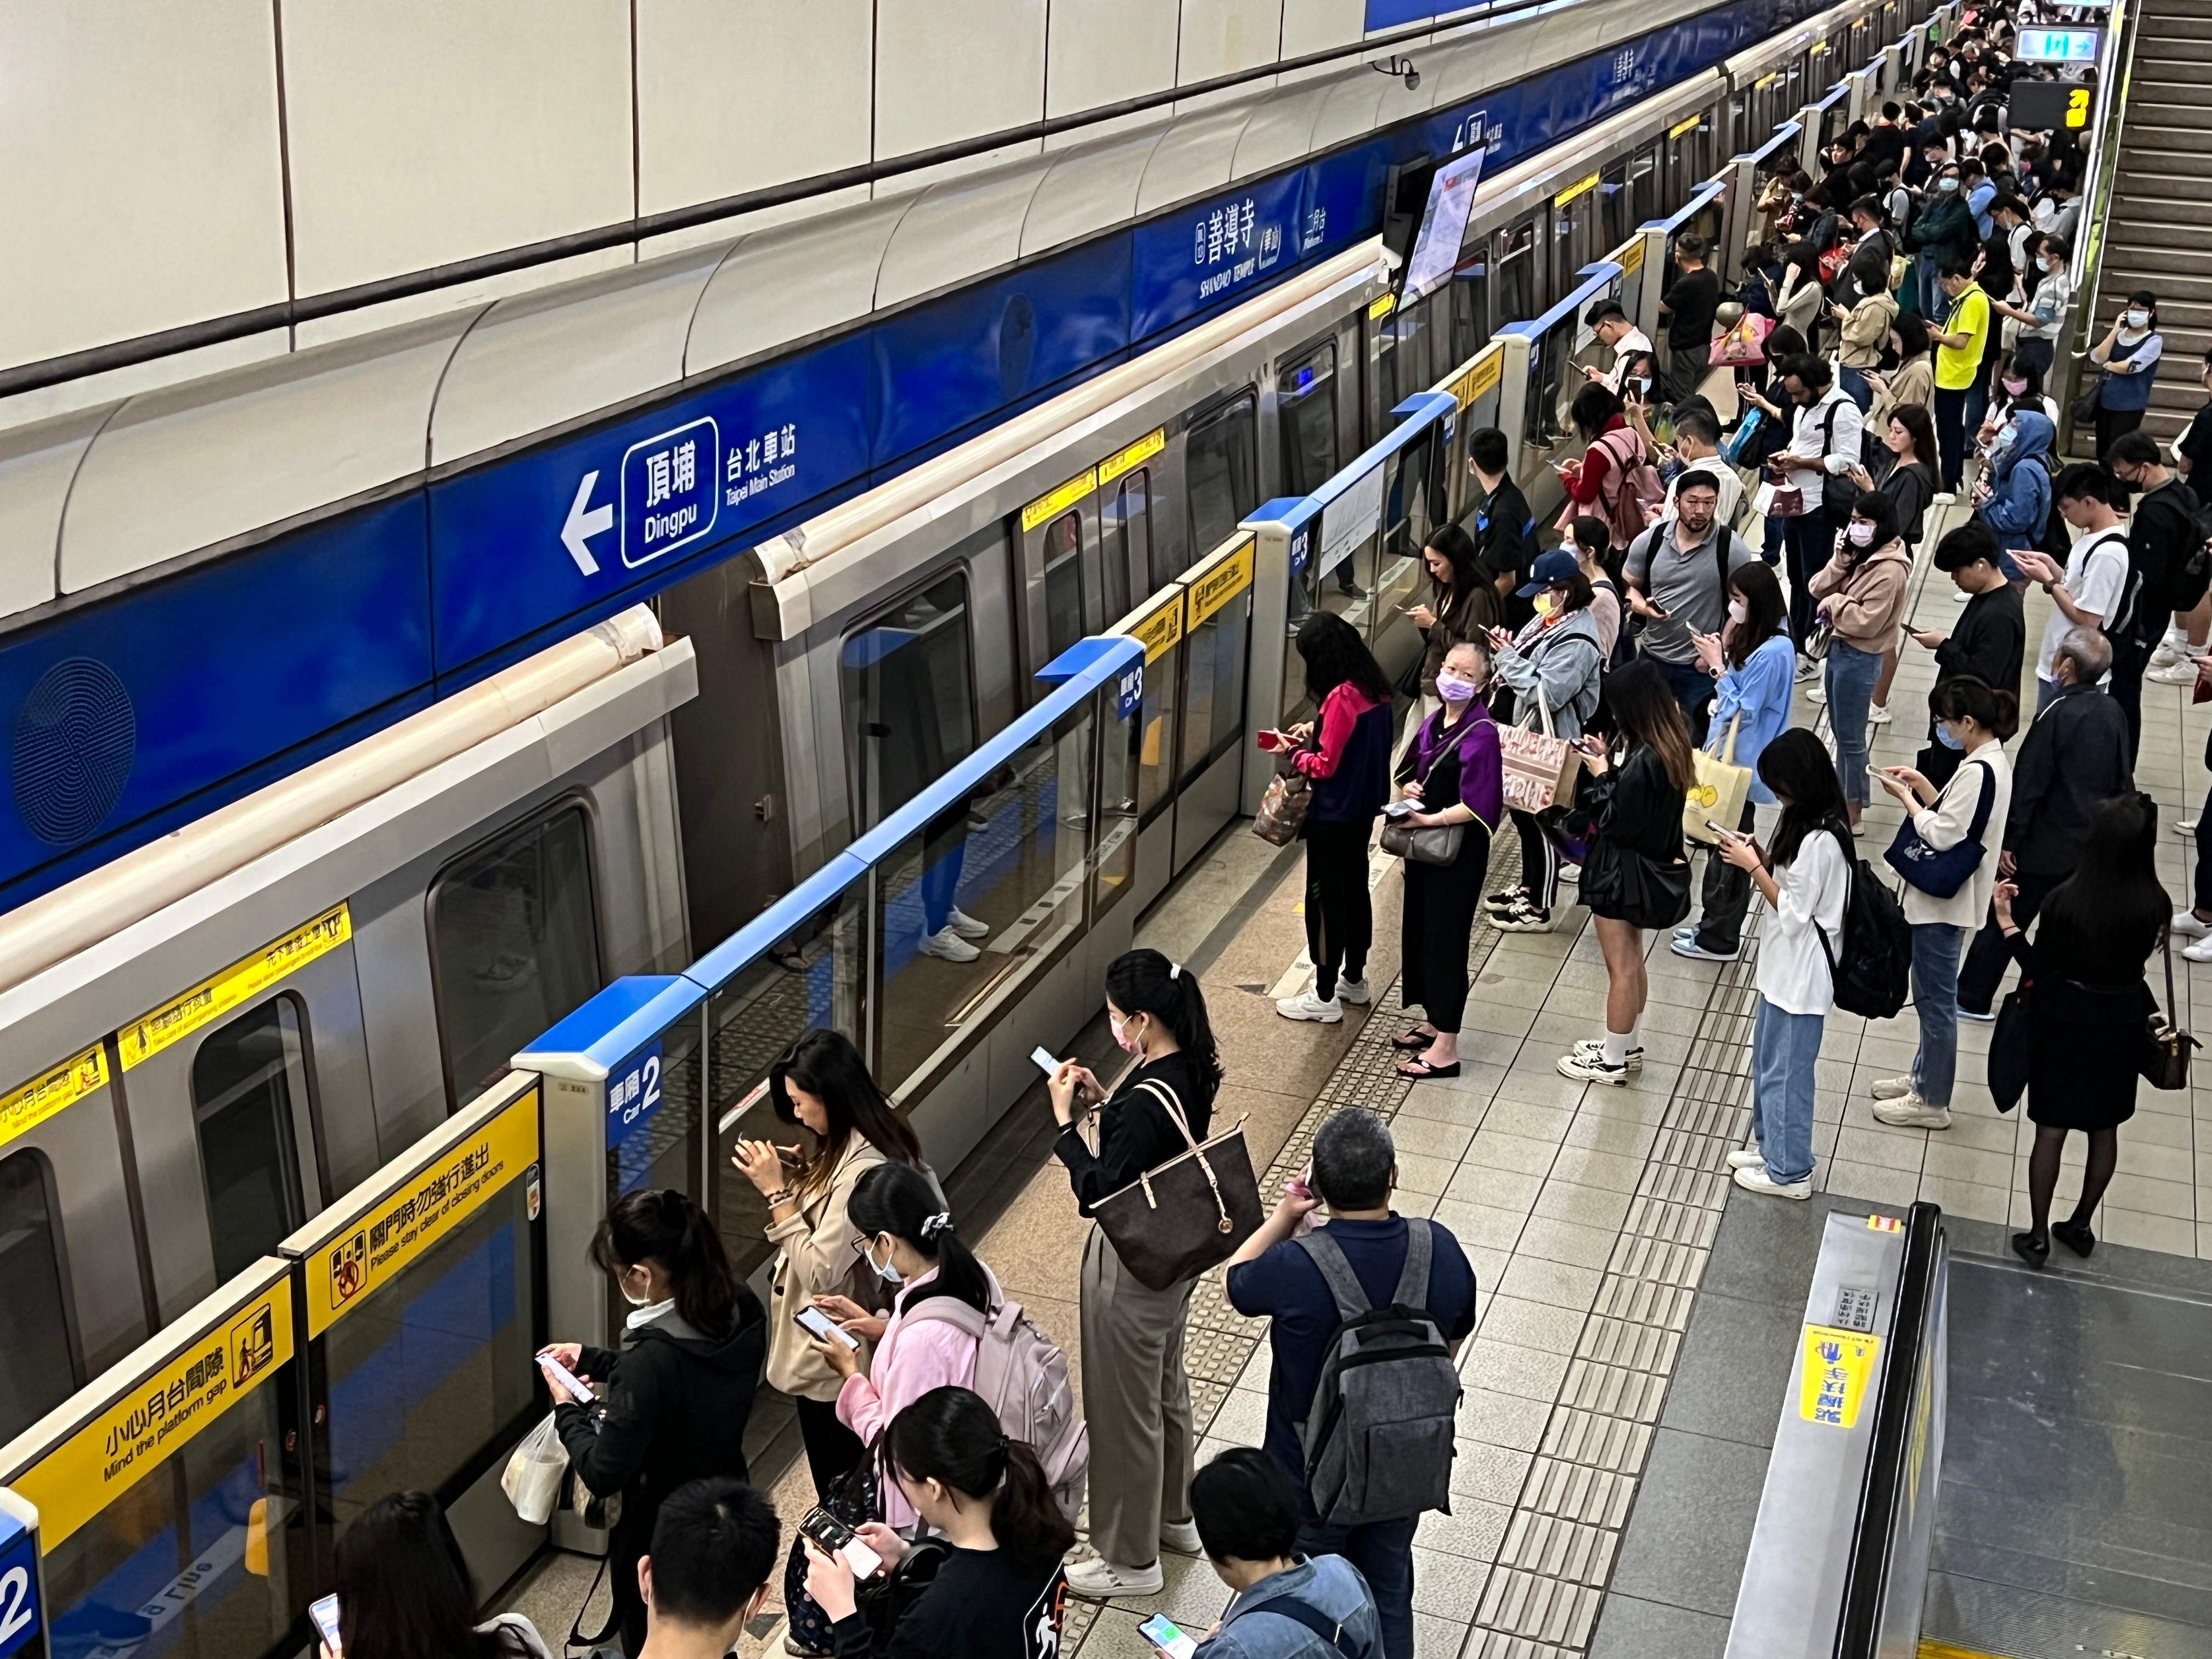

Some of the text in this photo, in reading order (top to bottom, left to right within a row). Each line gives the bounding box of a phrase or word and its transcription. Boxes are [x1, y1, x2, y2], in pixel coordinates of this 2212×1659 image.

[1208, 198, 1255, 265] 善導寺
[646, 439, 696, 508] 頂埔
[726, 464, 795, 506] Taipei Main Station
[727, 424, 795, 482] 台北車站
[645, 504, 697, 544] Dingpu
[1301, 531, 1308, 561] 3
[1133, 666, 1142, 700] 3
[642, 1056, 661, 1110] 2
[370, 1142, 489, 1254] 關門時勿強行進出
[371, 1160, 504, 1272] Please stay clear of closing doors
[104, 1378, 227, 1482] Mind the platform gap
[105, 1346, 224, 1457] 小心月台間隙
[0, 1566, 32, 1645] 2
